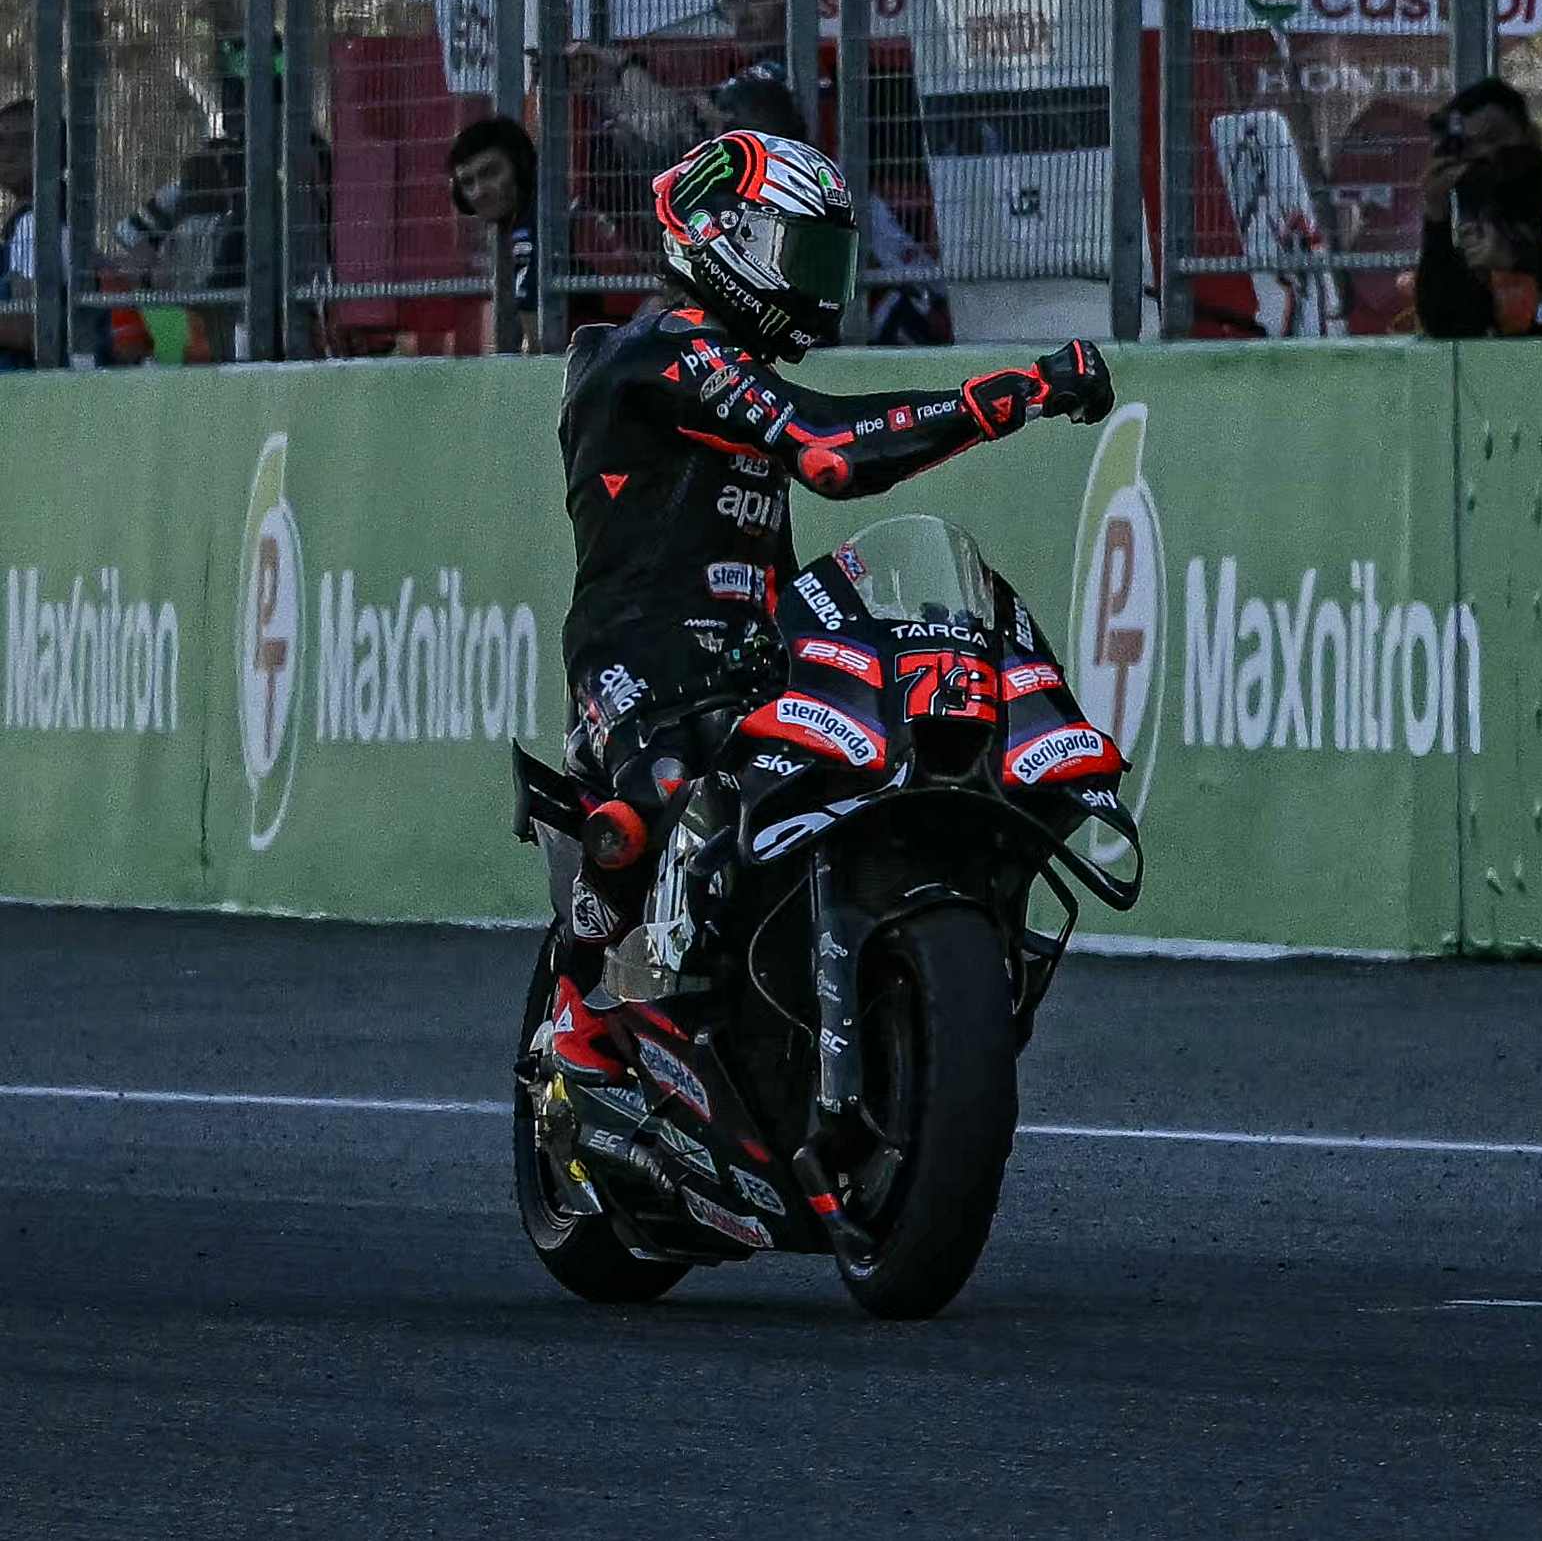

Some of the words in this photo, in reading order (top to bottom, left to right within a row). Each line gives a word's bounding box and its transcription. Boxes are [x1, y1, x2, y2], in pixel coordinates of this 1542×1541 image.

[855, 415, 885, 436] #be
[4, 566, 179, 733] Maxnitron
[316, 568, 538, 741] Maxnitron
[890, 622, 988, 649] TARGA
[800, 641, 870, 671] BS
[1184, 556, 1481, 757] Maxnitron
[781, 701, 871, 761] sterilgarda
[752, 753, 806, 777] sky
[1018, 732, 1100, 779] sterilgarda
[1081, 789, 1119, 810] sky
